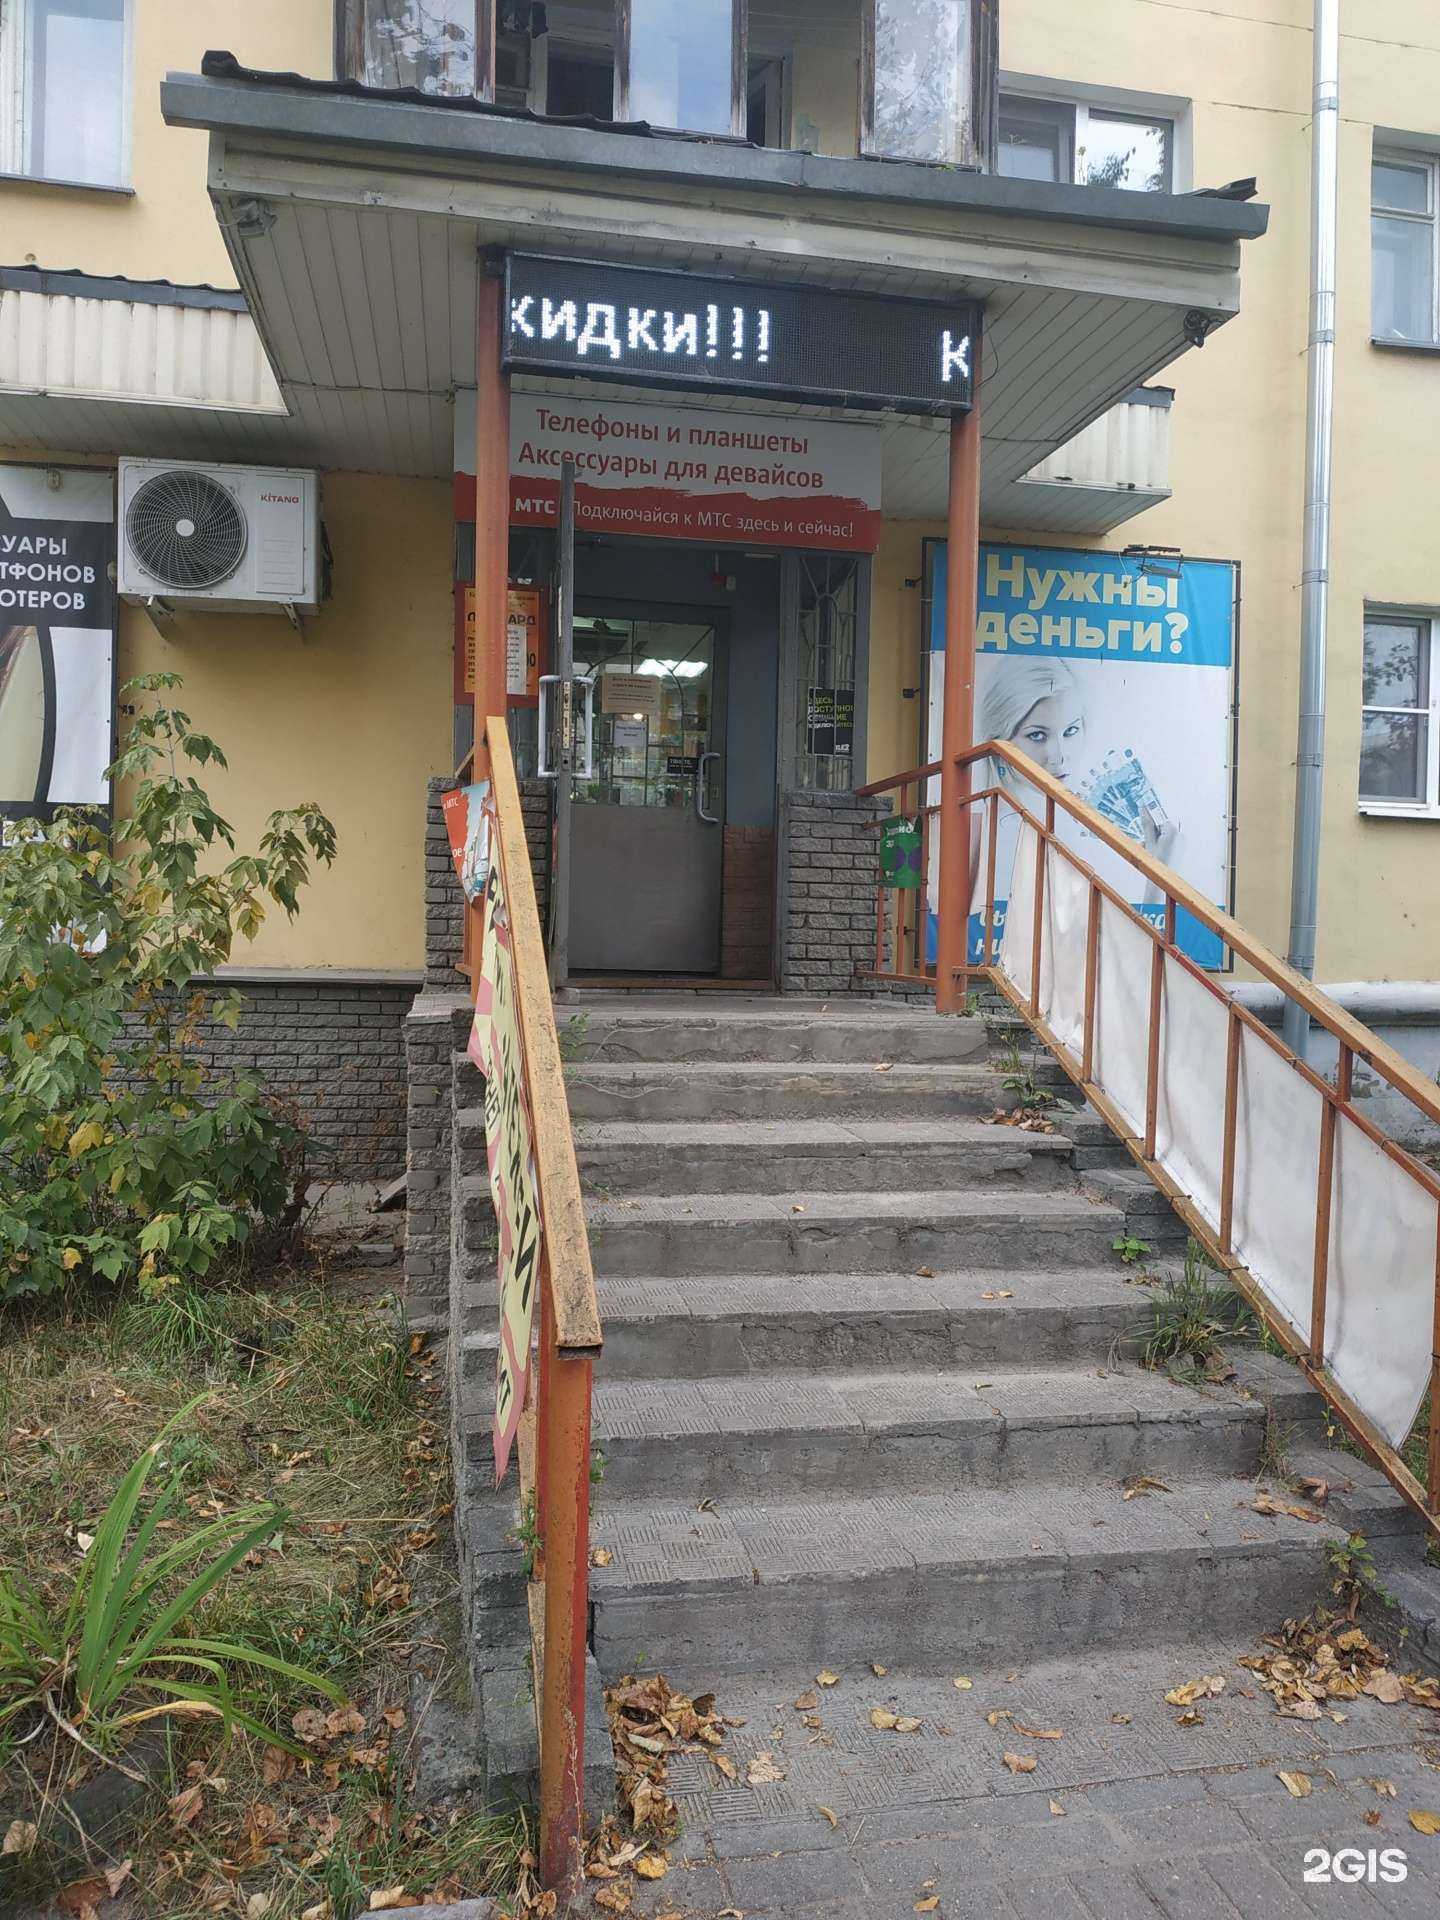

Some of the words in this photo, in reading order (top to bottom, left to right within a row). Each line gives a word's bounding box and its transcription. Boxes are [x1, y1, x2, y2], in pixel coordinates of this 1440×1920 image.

[536, 409, 658, 441] Телефоны
[667, 426, 681, 443] и
[689, 428, 809, 454] планшеты
[518, 442, 657, 477] Аксессуары
[664, 460, 707, 481] для
[714, 463, 823, 488] девайсов
[515, 498, 555, 514] МТС
[573, 501, 679, 524] Подключайся
[684, 513, 692, 526] к
[698, 511, 732, 528] МТС
[737, 517, 779, 532] здесь
[784, 521, 793, 532] и
[798, 520, 853, 538] сейчас!
[0, 535, 67, 555] УАРЫ
[986, 554, 1178, 611] Нужны
[975, 612, 1189, 655] деньги?
